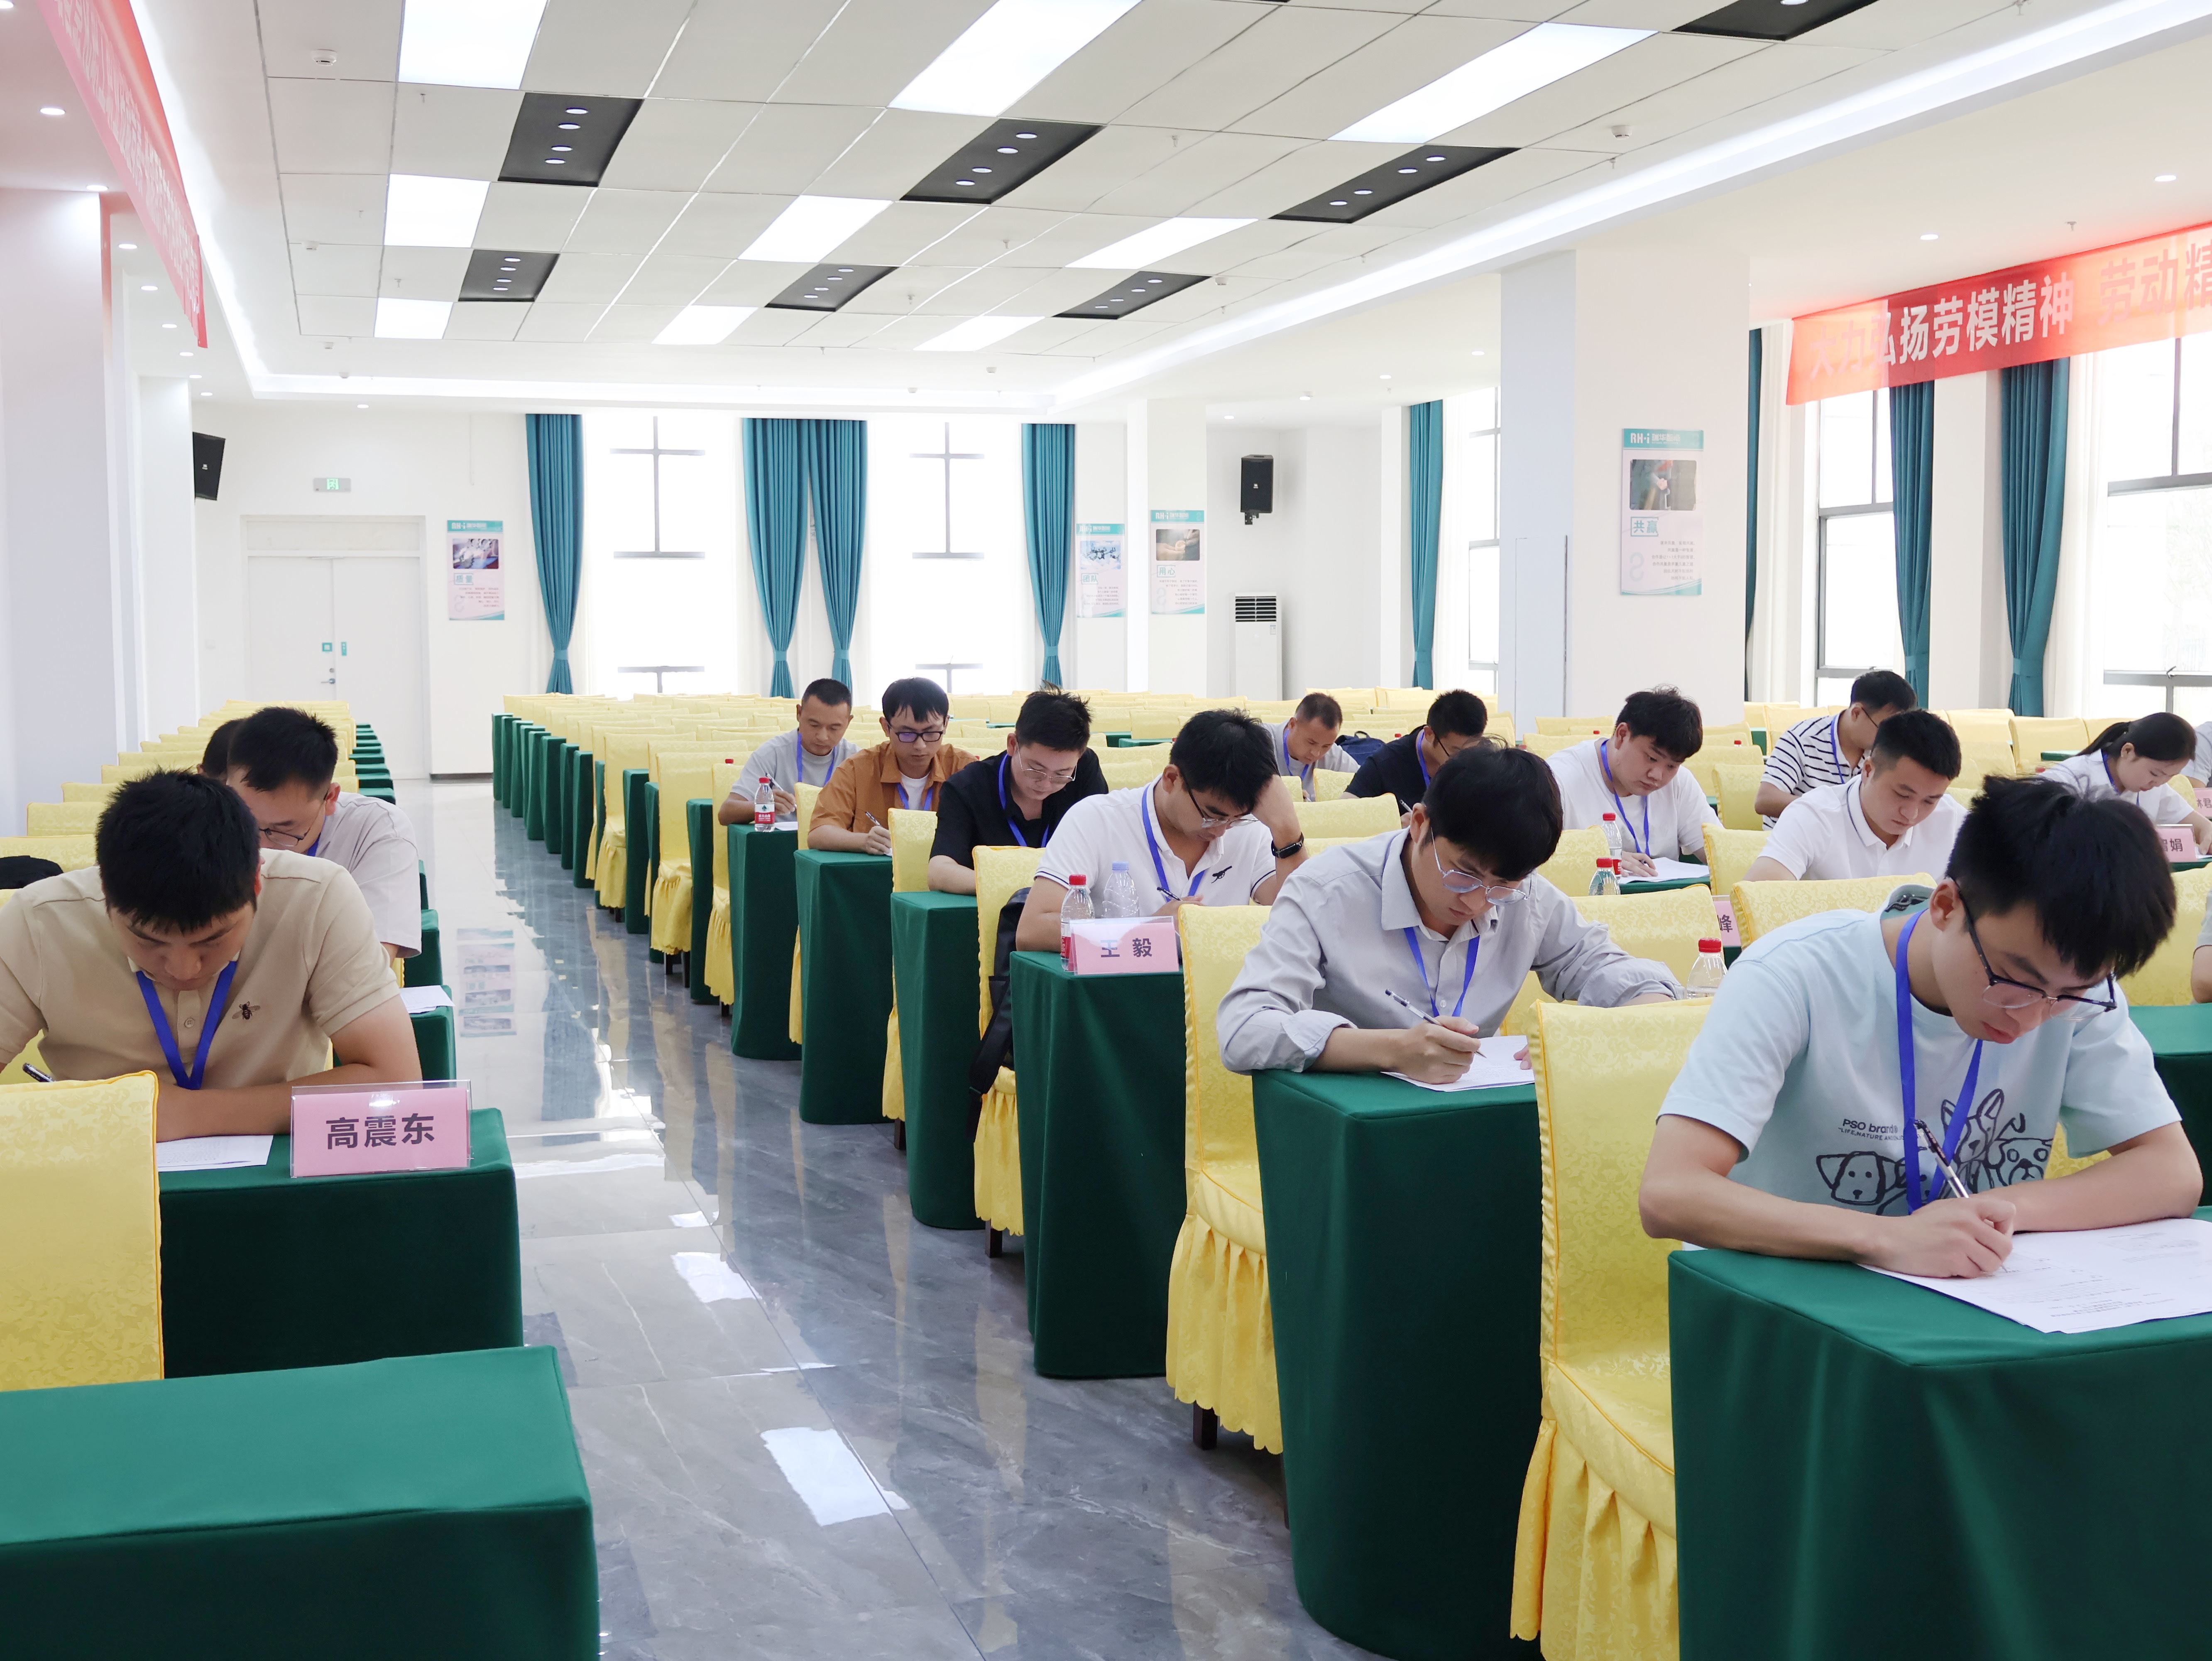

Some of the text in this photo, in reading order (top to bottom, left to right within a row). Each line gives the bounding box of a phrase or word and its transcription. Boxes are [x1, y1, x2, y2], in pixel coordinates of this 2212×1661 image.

[1809, 272, 2075, 381] 大力弘扬劳模精神
[1159, 566, 1175, 576] 用心
[326, 1113, 435, 1150] 高震东
[1843, 1118, 1867, 1130] PSO
